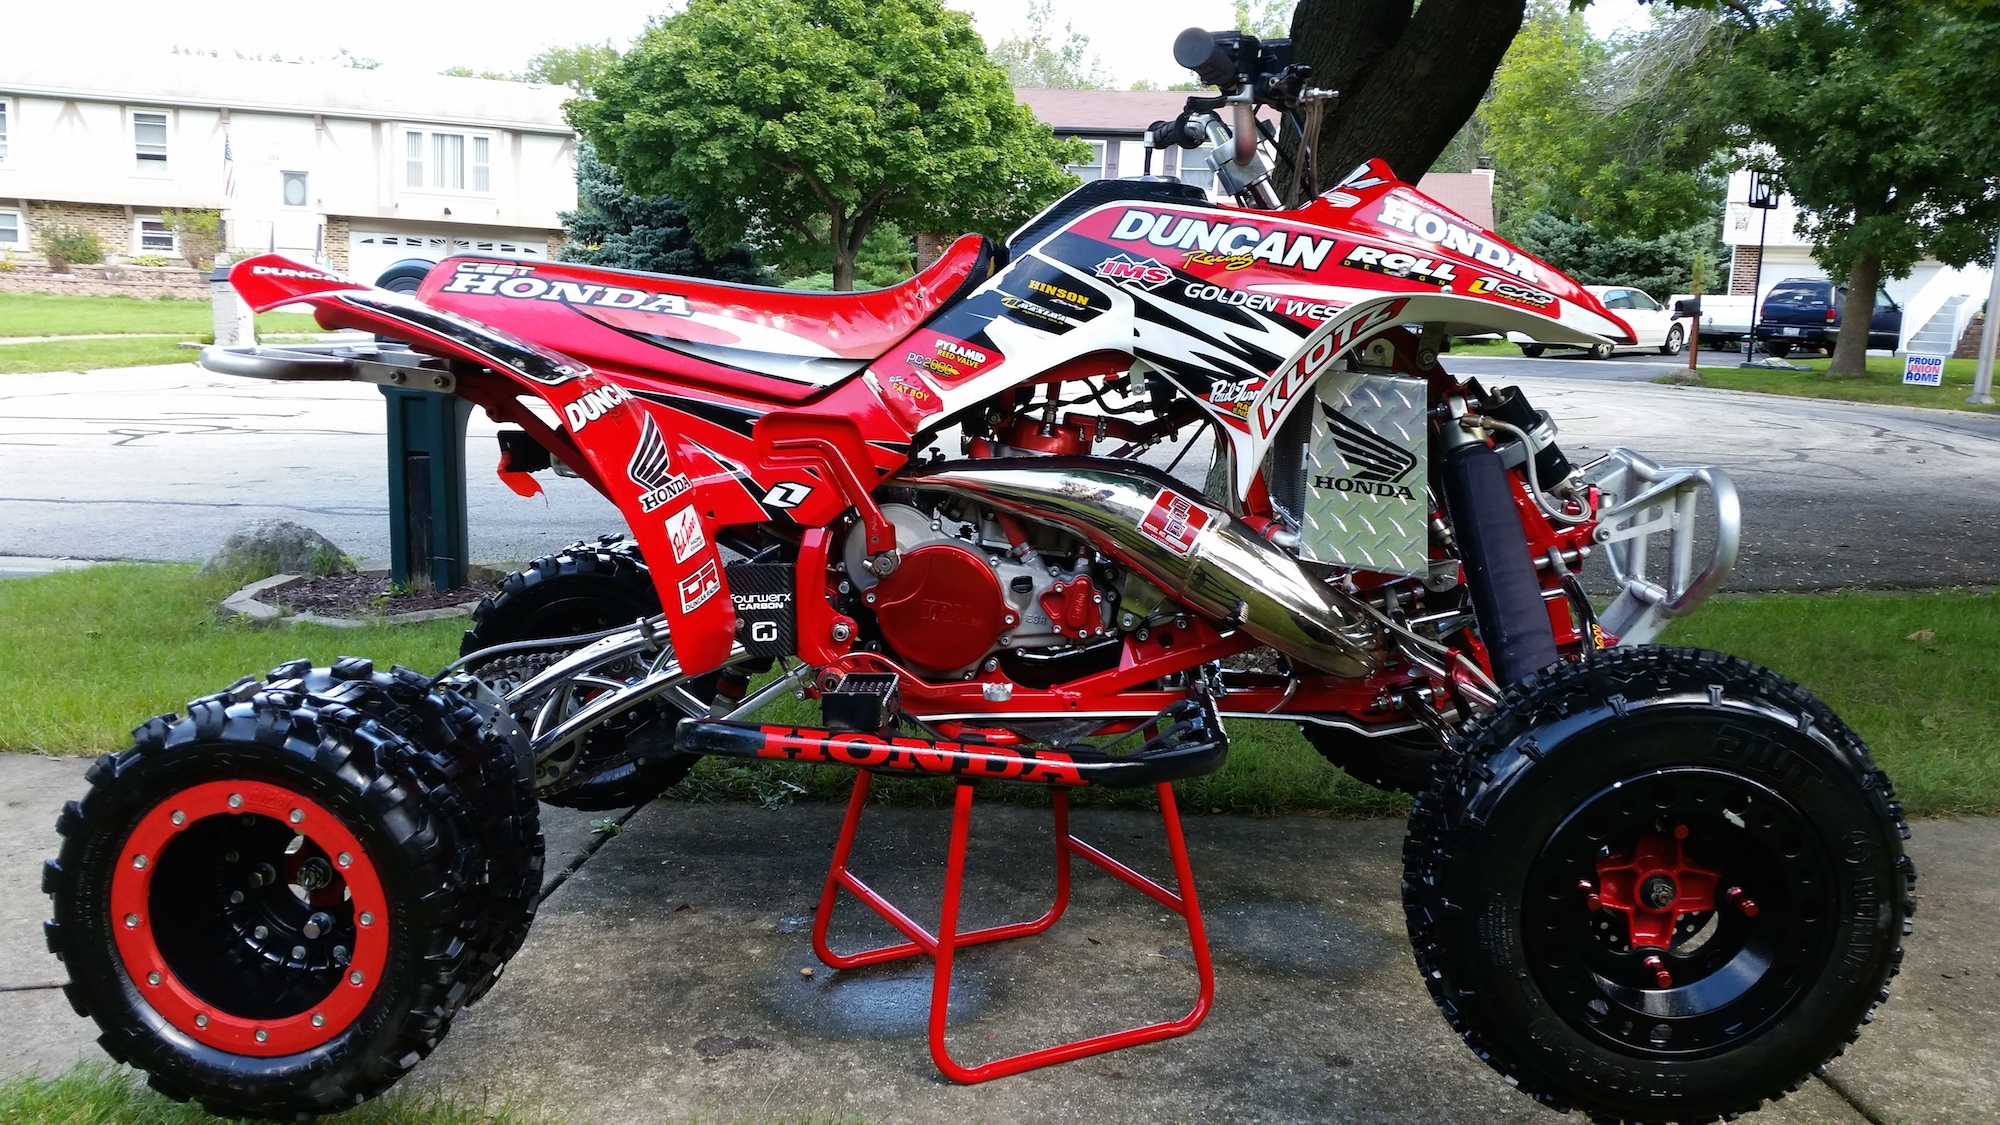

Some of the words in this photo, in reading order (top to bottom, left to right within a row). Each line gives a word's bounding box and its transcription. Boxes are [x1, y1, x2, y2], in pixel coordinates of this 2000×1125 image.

[1110, 208, 1335, 272] DUNCAN
[1376, 195, 1539, 284] HONDA
[1101, 260, 1171, 284] IMS
[1180, 249, 1255, 271] Racing
[1343, 259, 1447, 286] DESGN
[1345, 244, 1458, 282] ROLL
[252, 264, 357, 287] DUNCAN
[442, 272, 696, 317] HONDA
[1027, 280, 1090, 306] HINSON
[1184, 282, 1280, 314] GOLDEN
[934, 338, 987, 364] PYRAMID
[937, 349, 955, 361] REED
[957, 355, 980, 369] VALVE
[1908, 356, 1942, 366] PROUD
[1260, 299, 1398, 431] KLOTZ
[1907, 364, 1940, 374] UNION
[892, 382, 908, 394] FAT
[909, 387, 930, 402] BOY
[641, 476, 692, 512] HONDA
[1313, 475, 1416, 501] HONDA
[737, 602, 784, 611] CARBON
[921, 599, 972, 625] TRX
[757, 725, 1089, 786] HONDA
